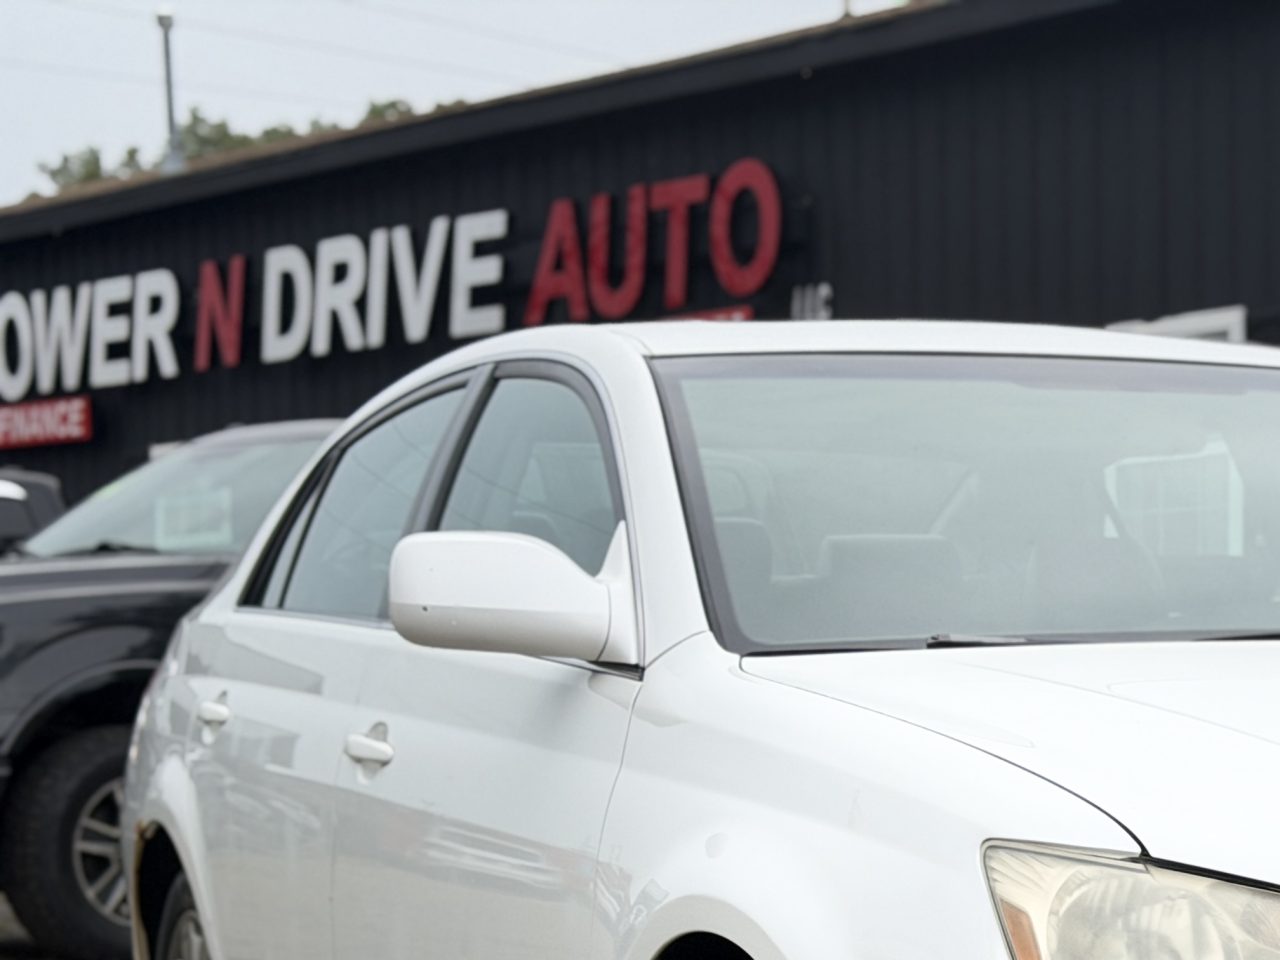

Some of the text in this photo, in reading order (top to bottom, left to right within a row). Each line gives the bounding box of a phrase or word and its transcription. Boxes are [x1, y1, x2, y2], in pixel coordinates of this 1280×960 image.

[195, 254, 246, 373] N
[261, 208, 508, 364] DRIVE
[522, 157, 782, 326] AUTO
